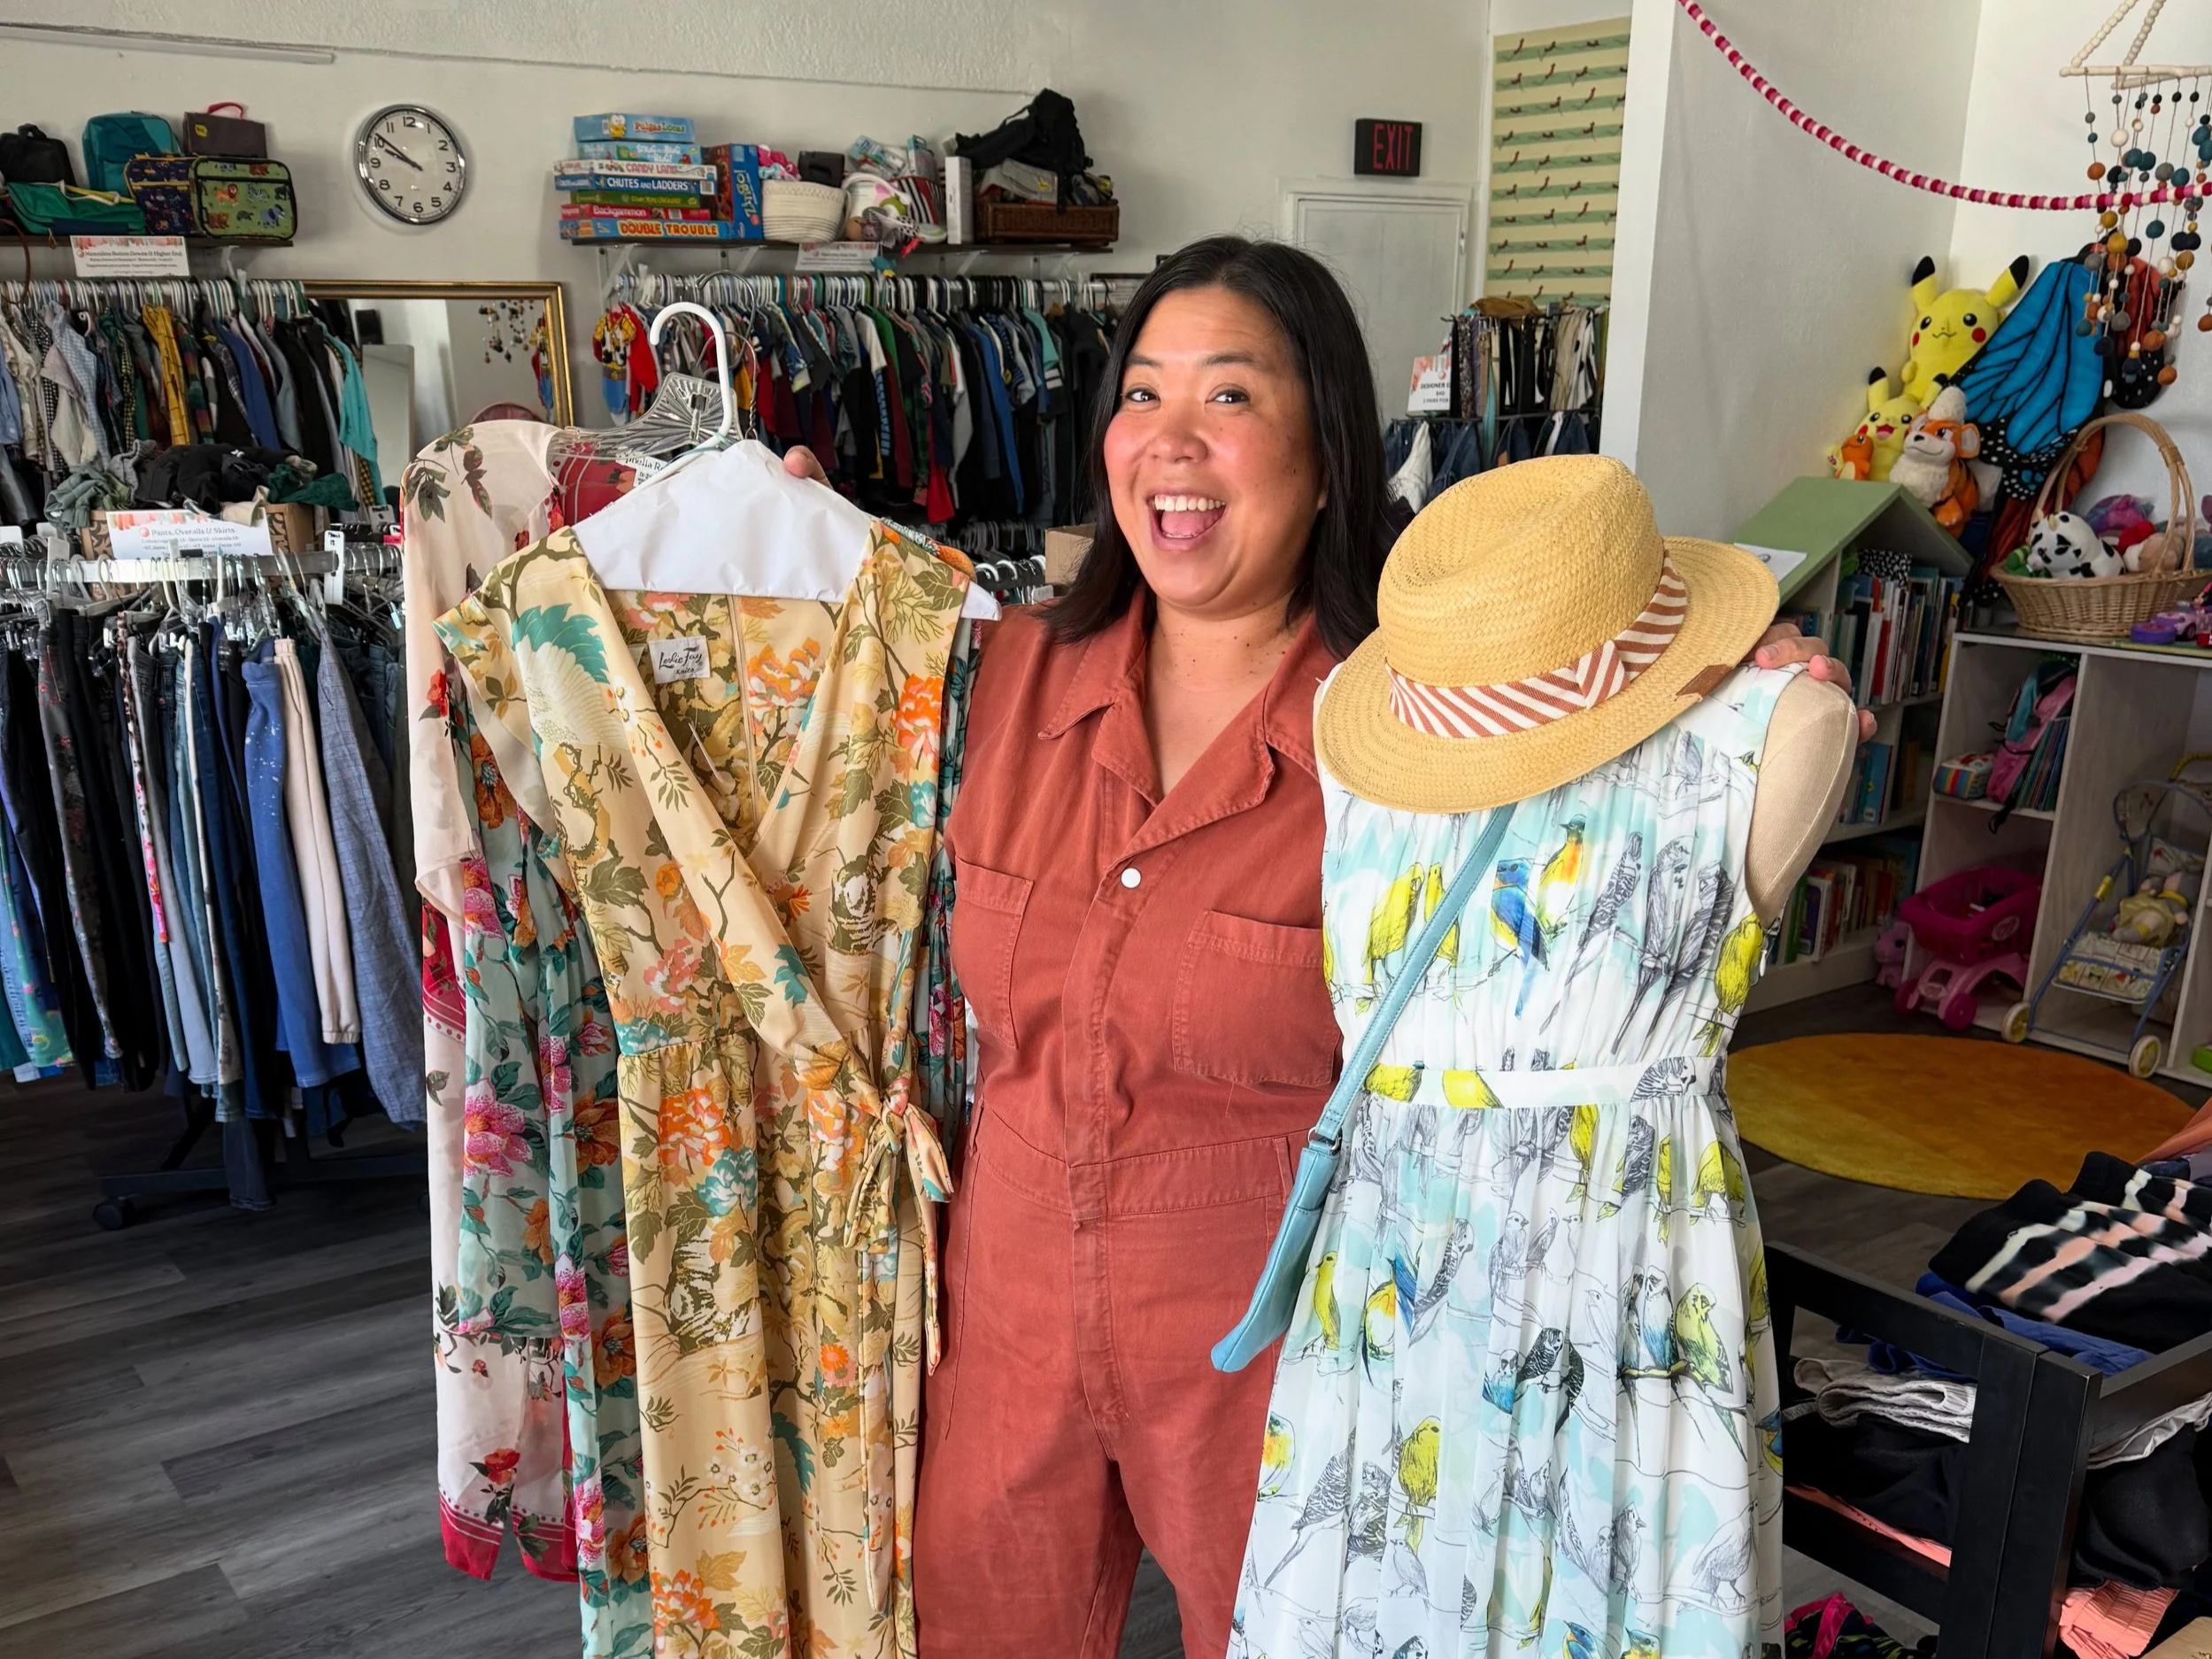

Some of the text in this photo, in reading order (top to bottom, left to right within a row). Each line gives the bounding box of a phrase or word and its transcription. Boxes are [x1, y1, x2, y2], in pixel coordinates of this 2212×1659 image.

[386, 122, 394, 133] 11
[403, 116, 418, 128] 12
[427, 123, 431, 134] 1
[374, 136, 385, 148] 10
[438, 140, 448, 151] 2
[1373, 123, 1414, 170] EXIT
[370, 157, 381, 169] 9
[446, 162, 456, 173] 3
[626, 163, 677, 174] CANDY LAND
[379, 179, 390, 191] 8
[443, 181, 452, 192] 4
[607, 177, 640, 189] CHUTES
[652, 180, 689, 190] LADDERS
[393, 196, 404, 207] 7
[431, 197, 442, 208] 5
[412, 202, 424, 213] 6
[593, 205, 647, 217] Backgammon
[620, 222, 717, 235] DOUBLE TROUBLE
[659, 644, 702, 670] Leslie Fay
